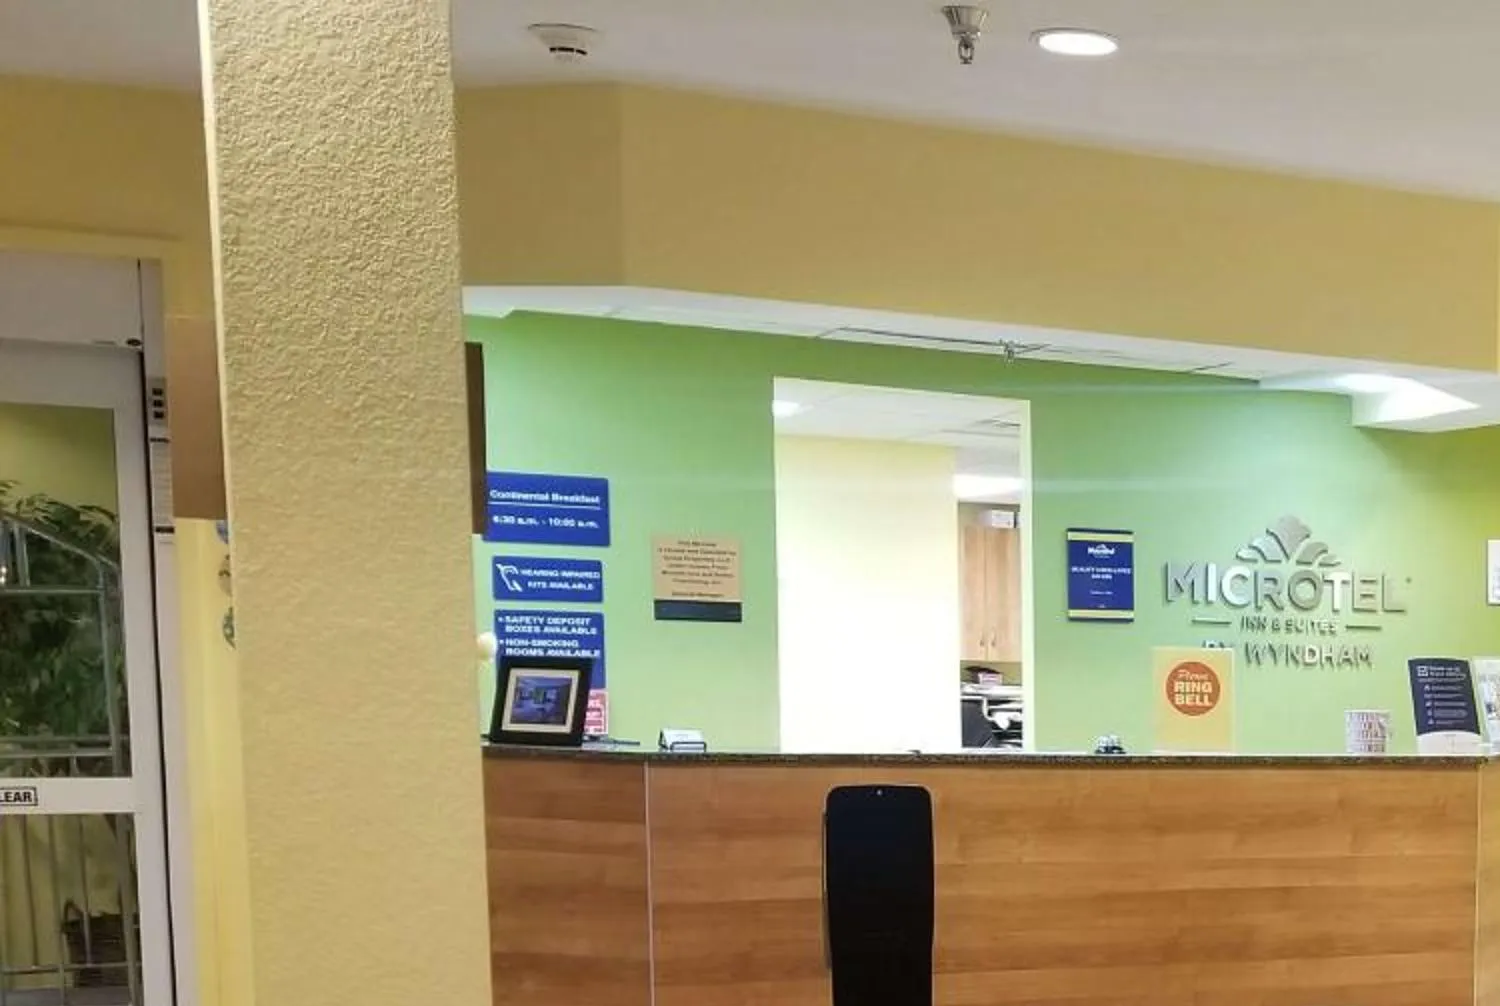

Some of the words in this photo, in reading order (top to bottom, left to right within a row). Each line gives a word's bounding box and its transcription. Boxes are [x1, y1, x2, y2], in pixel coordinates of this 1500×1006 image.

[490, 489, 549, 501] Continental
[551, 492, 600, 503] Breakfast
[521, 569, 559, 577] HEARING
[562, 570, 600, 578] IMPAIRED
[527, 581, 548, 589] KITS
[549, 581, 594, 591] AVAILABLE
[1164, 561, 1408, 614] MICROTEL
[506, 616, 546, 625] SAFETY
[547, 617, 593, 626] DEPOSIT
[1239, 615, 1268, 631] INN
[1271, 617, 1281, 632] &
[1284, 618, 1341, 635] SUITES
[506, 625, 541, 634] BOXES
[543, 626, 597, 635] AVAILABLE
[506, 638, 579, 648] NON-SMOKING
[506, 647, 545, 657] ROOMS
[546, 649, 600, 658] AVAILABLE
[1244, 641, 1374, 669] WYNDHAM
[1174, 680, 1213, 693] RING
[1174, 692, 1212, 706] BELL
